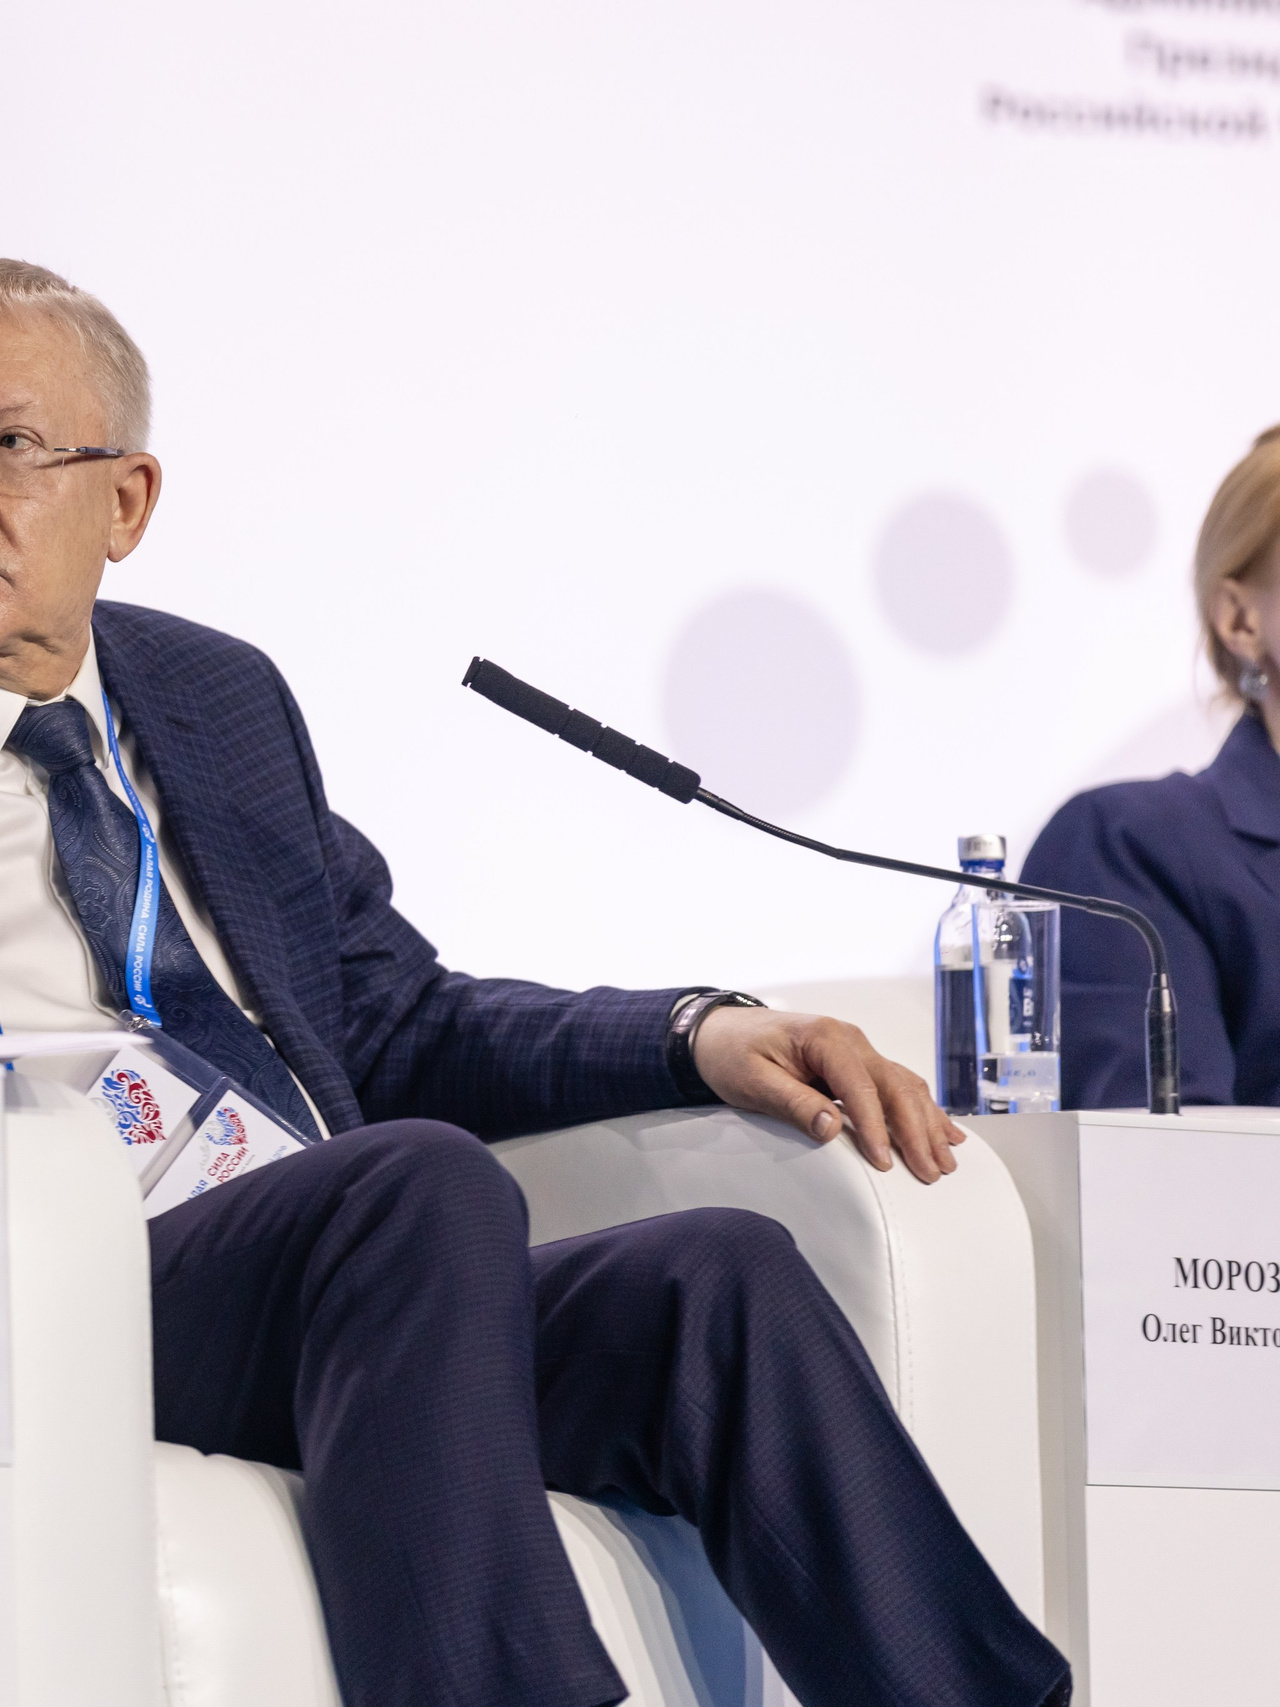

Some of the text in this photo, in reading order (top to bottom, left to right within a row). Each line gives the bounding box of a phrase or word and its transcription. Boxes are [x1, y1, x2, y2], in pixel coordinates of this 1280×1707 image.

[133, 844, 154, 992] МАЛАЯ РОДИНА СИЛА РОССИИ
[207, 1152, 230, 1177] СИЛА
[217, 1146, 250, 1184] РОССИИ
[1173, 1257, 1280, 1293] МОРОЗ
[1142, 1313, 1203, 1343] Олег
